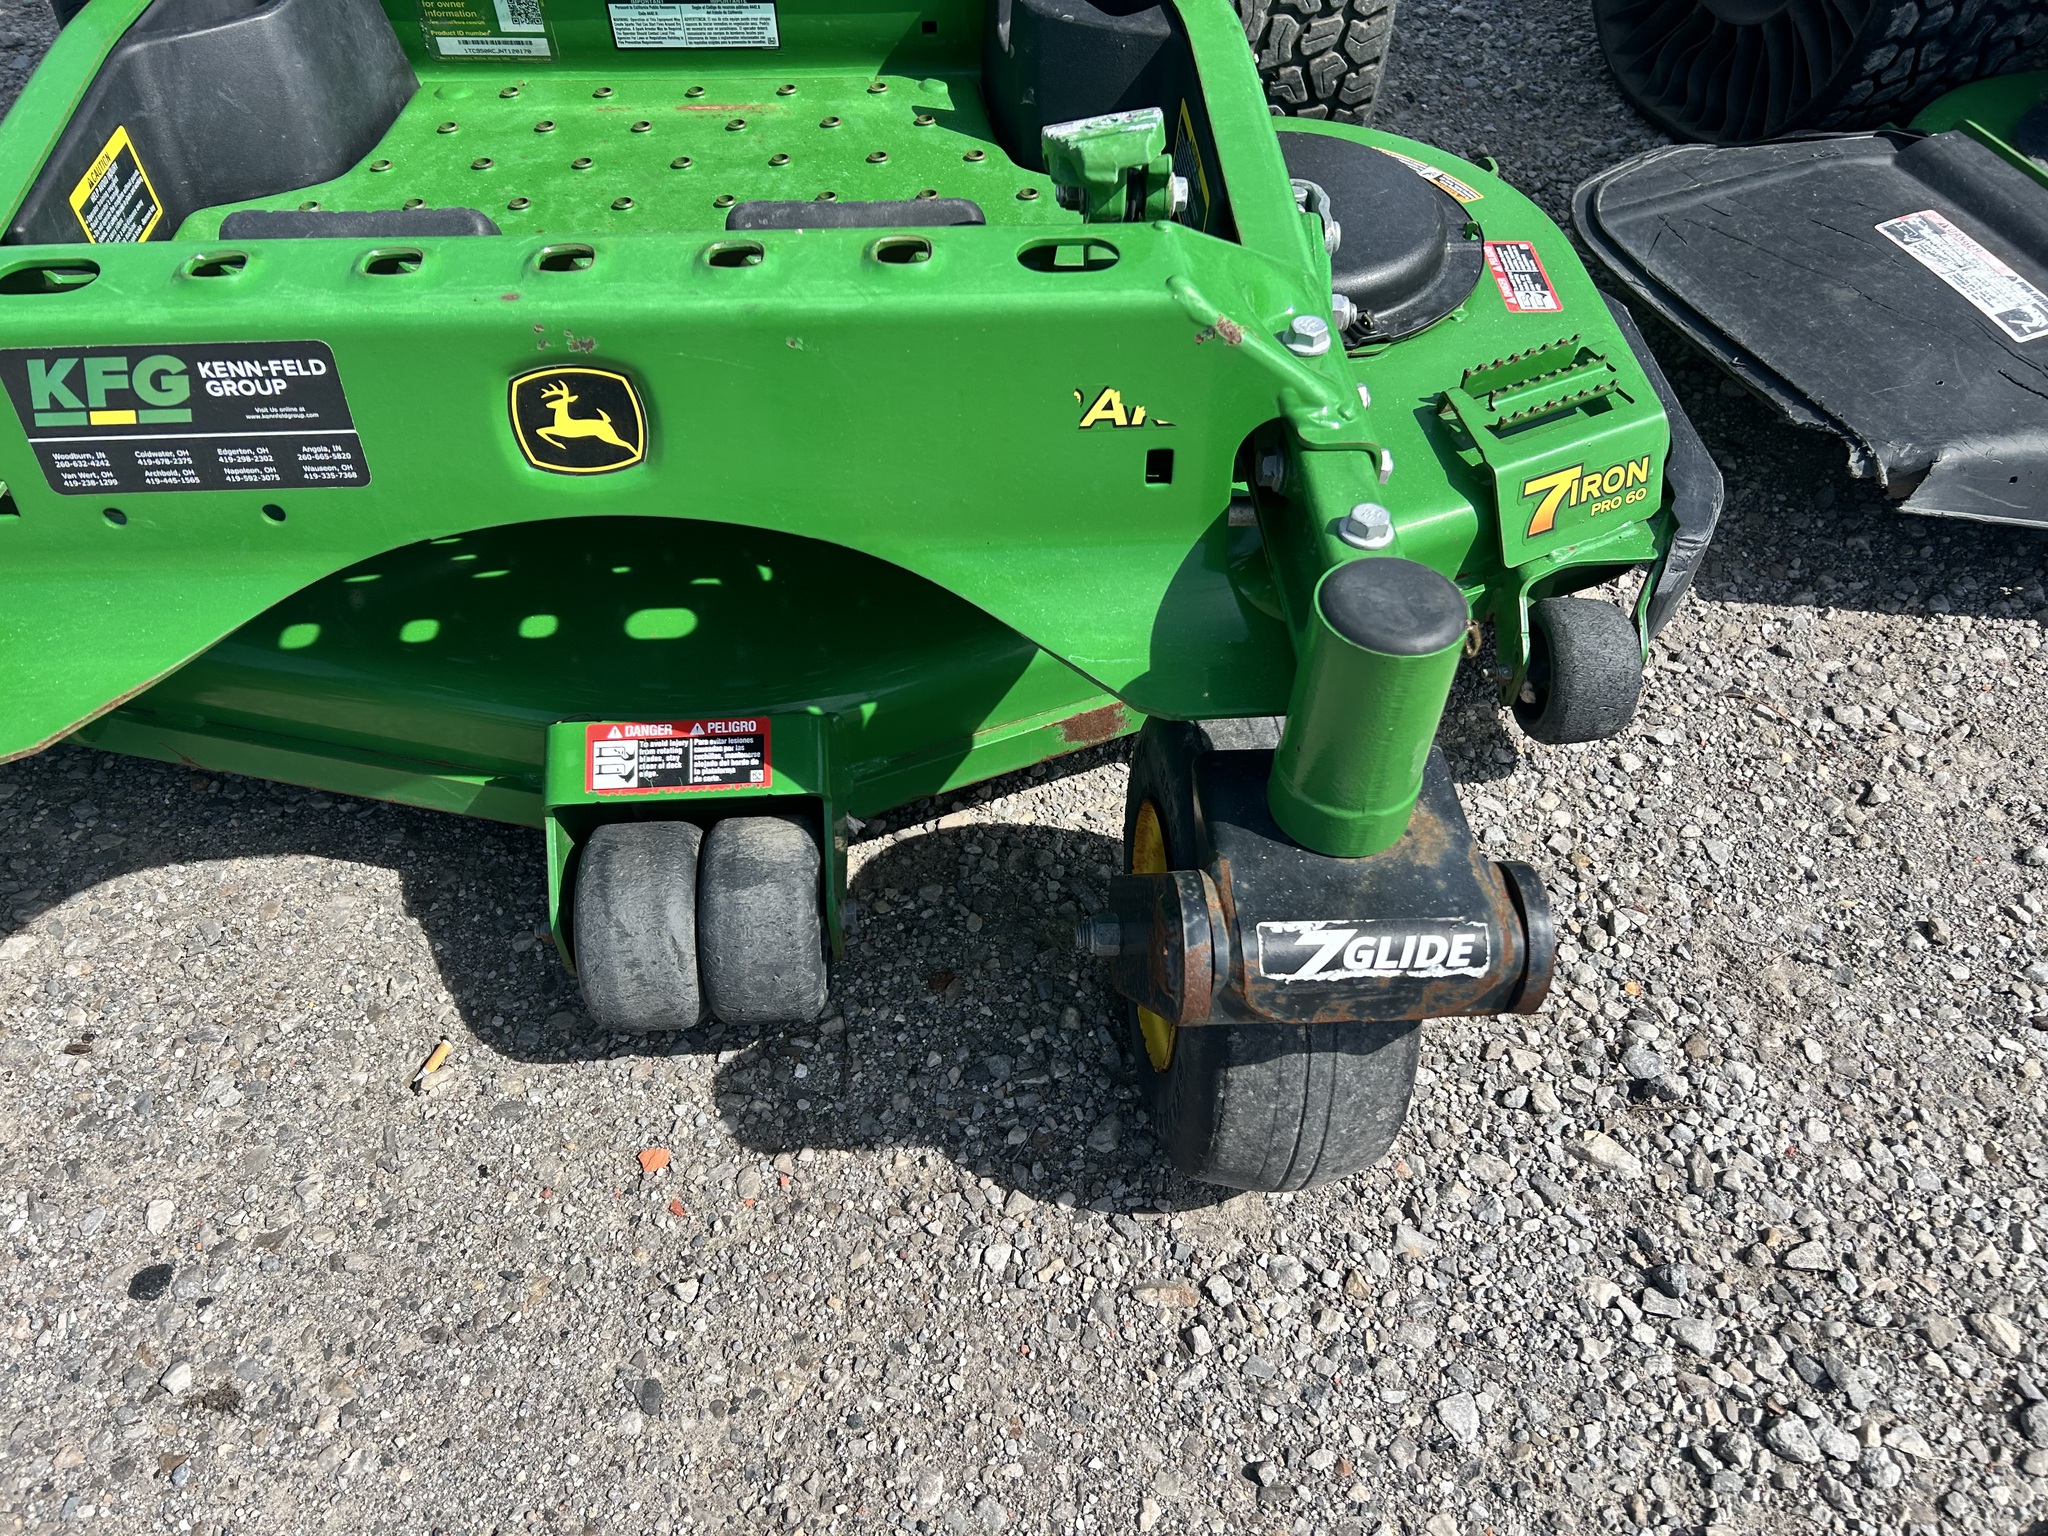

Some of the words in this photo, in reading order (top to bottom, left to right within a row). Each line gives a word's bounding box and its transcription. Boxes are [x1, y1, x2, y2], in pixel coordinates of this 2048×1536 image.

[197, 359, 326, 378] KENN-FELD
[27, 354, 190, 409] KFG
[205, 378, 287, 397] GROUP
[217, 448, 255, 456] Edgerton,
[55, 460, 110, 468] 260-632-4242
[226, 474, 280, 482] 419-592-3075
[304, 472, 357, 480] 419-335-7368
[64, 479, 118, 487] 419-238-1299
[1590, 497, 1622, 517] PRO
[1625, 488, 1647, 504] 60
[625, 724, 673, 737] DANGER
[707, 720, 757, 733] PELIGRO
[670, 740, 689, 748] injury
[657, 747, 682, 755] rotating
[730, 758, 750, 766] borde
[702, 767, 736, 776] plataforma
